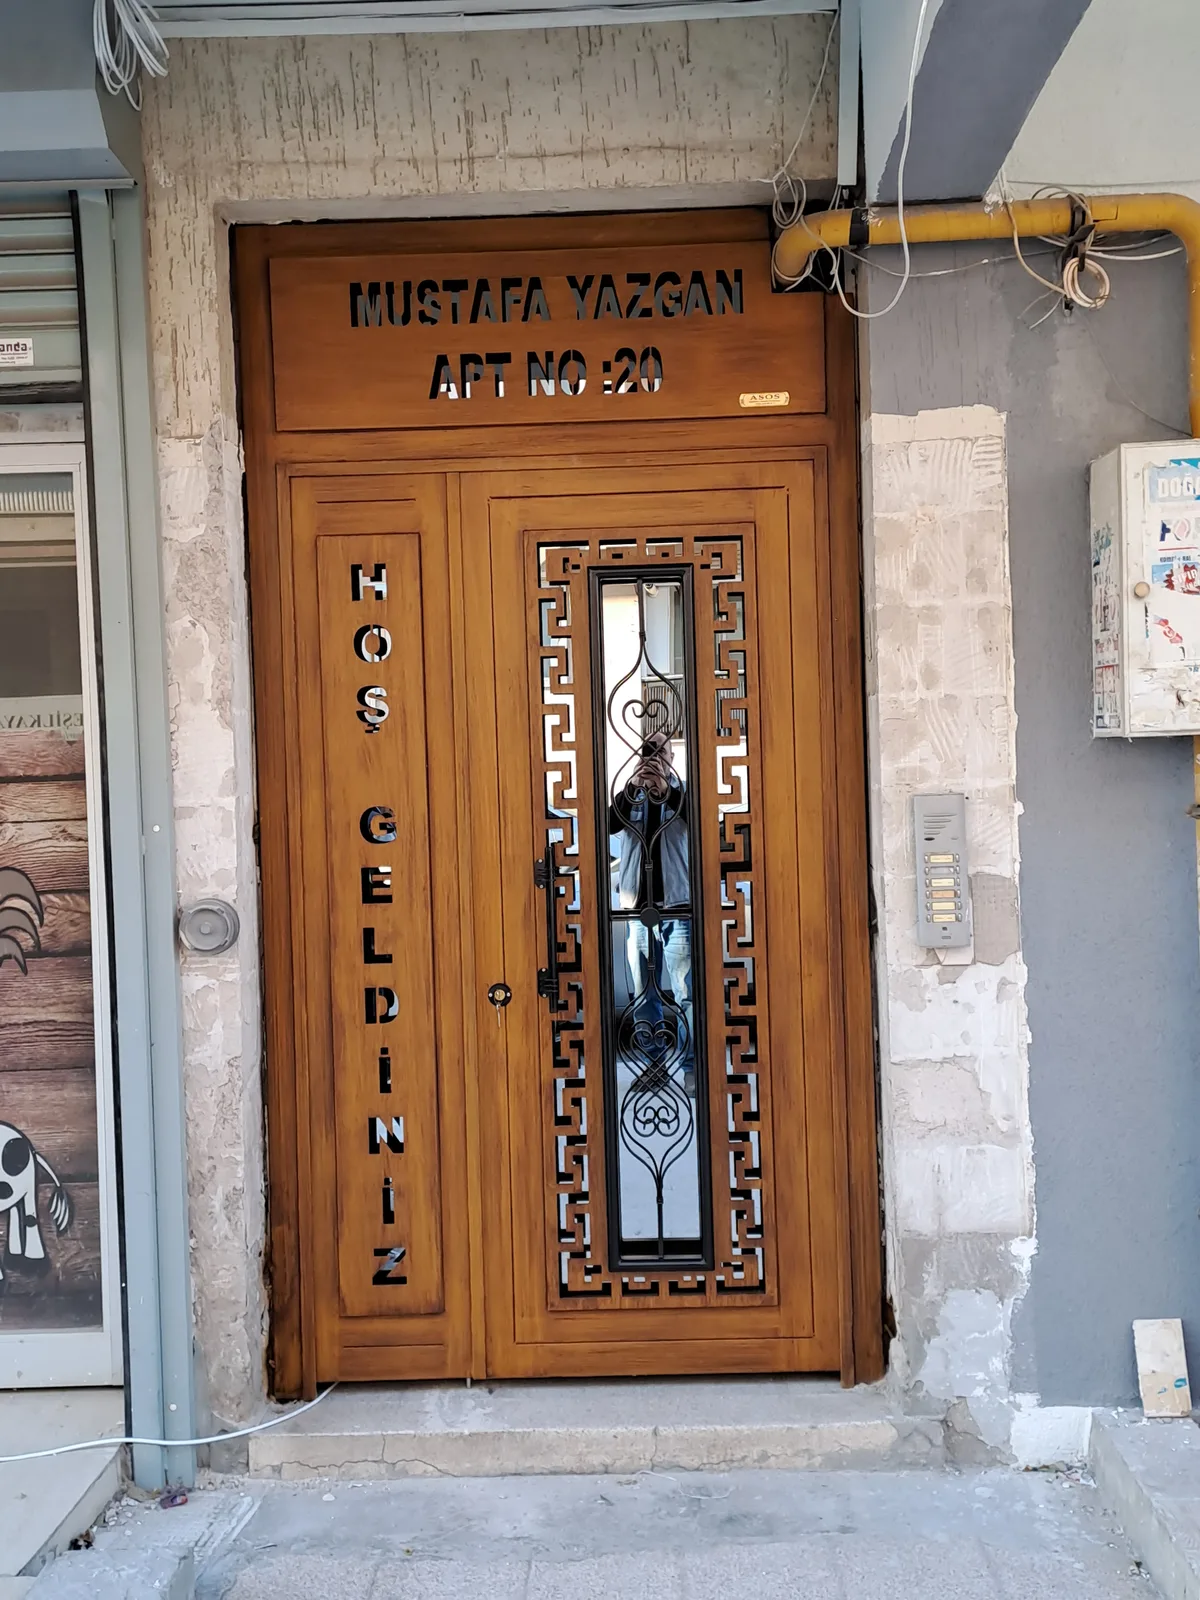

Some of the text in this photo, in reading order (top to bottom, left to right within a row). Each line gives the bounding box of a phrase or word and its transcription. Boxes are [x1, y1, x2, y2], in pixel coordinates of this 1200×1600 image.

[349, 268, 744, 328] MUSTAFA YAZGAN
[429, 352, 512, 400] APT
[527, 350, 587, 397] NO
[750, 393, 780, 401] ASOS
[351, 562, 392, 734] HOŞ
